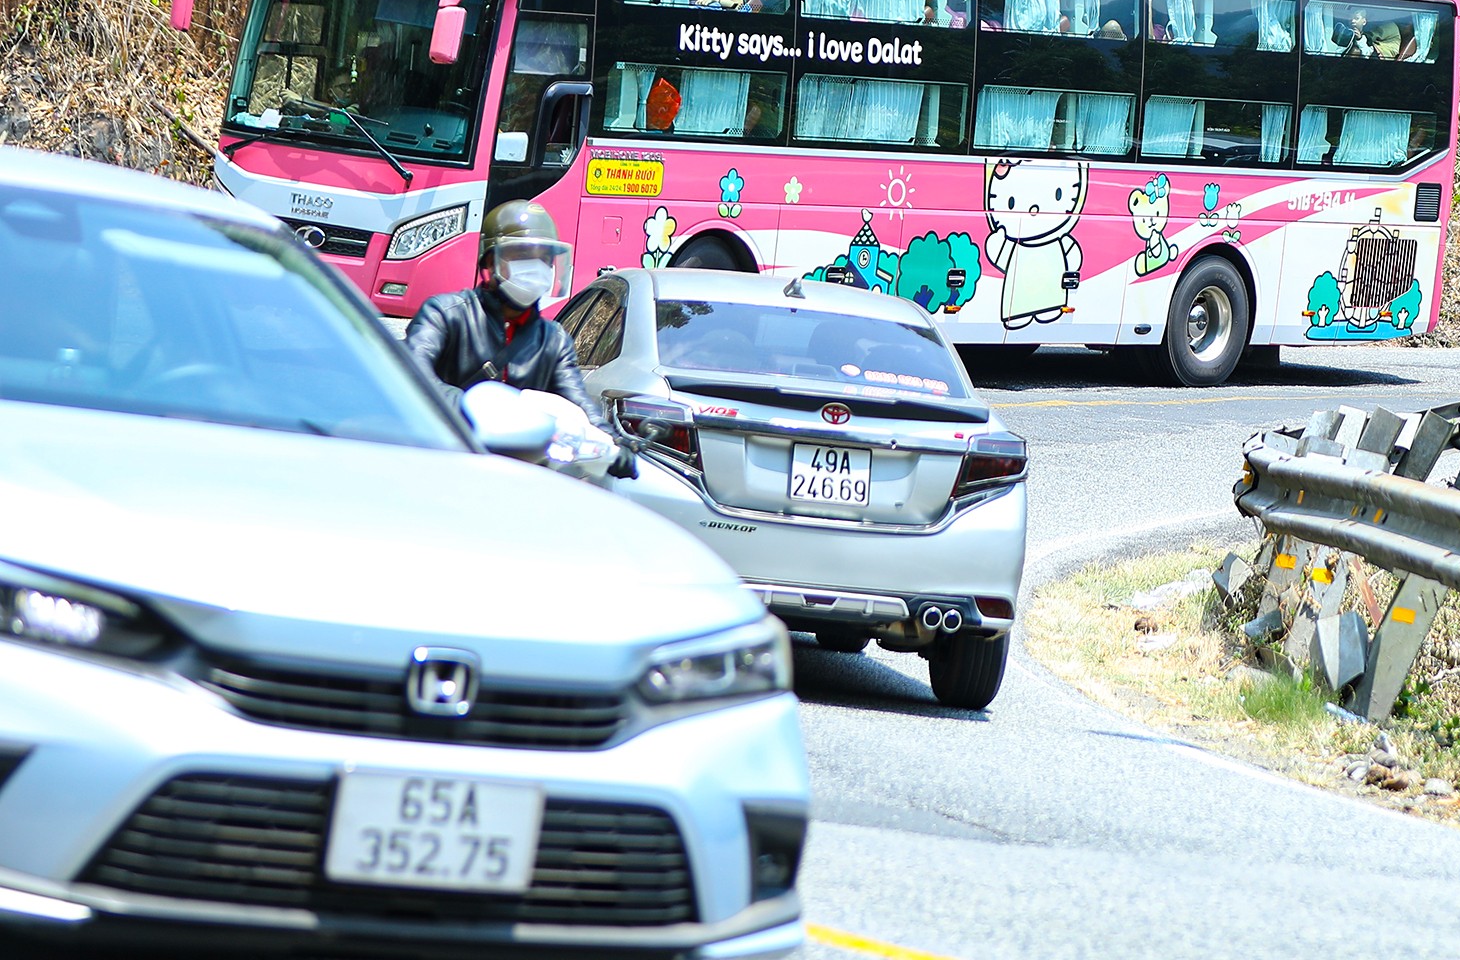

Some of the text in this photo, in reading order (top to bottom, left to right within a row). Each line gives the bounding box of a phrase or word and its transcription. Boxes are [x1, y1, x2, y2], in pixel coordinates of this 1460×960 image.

[679, 24, 923, 66] Kitty says... i love Dalat
[623, 183, 640, 193] 1900
[640, 184, 658, 194] 6079
[811, 448, 851, 475] 49A
[793, 474, 866, 503] 246.69
[707, 520, 758, 533] DUNLOP
[399, 778, 479, 825] 65A
[357, 827, 512, 882] 352.75
